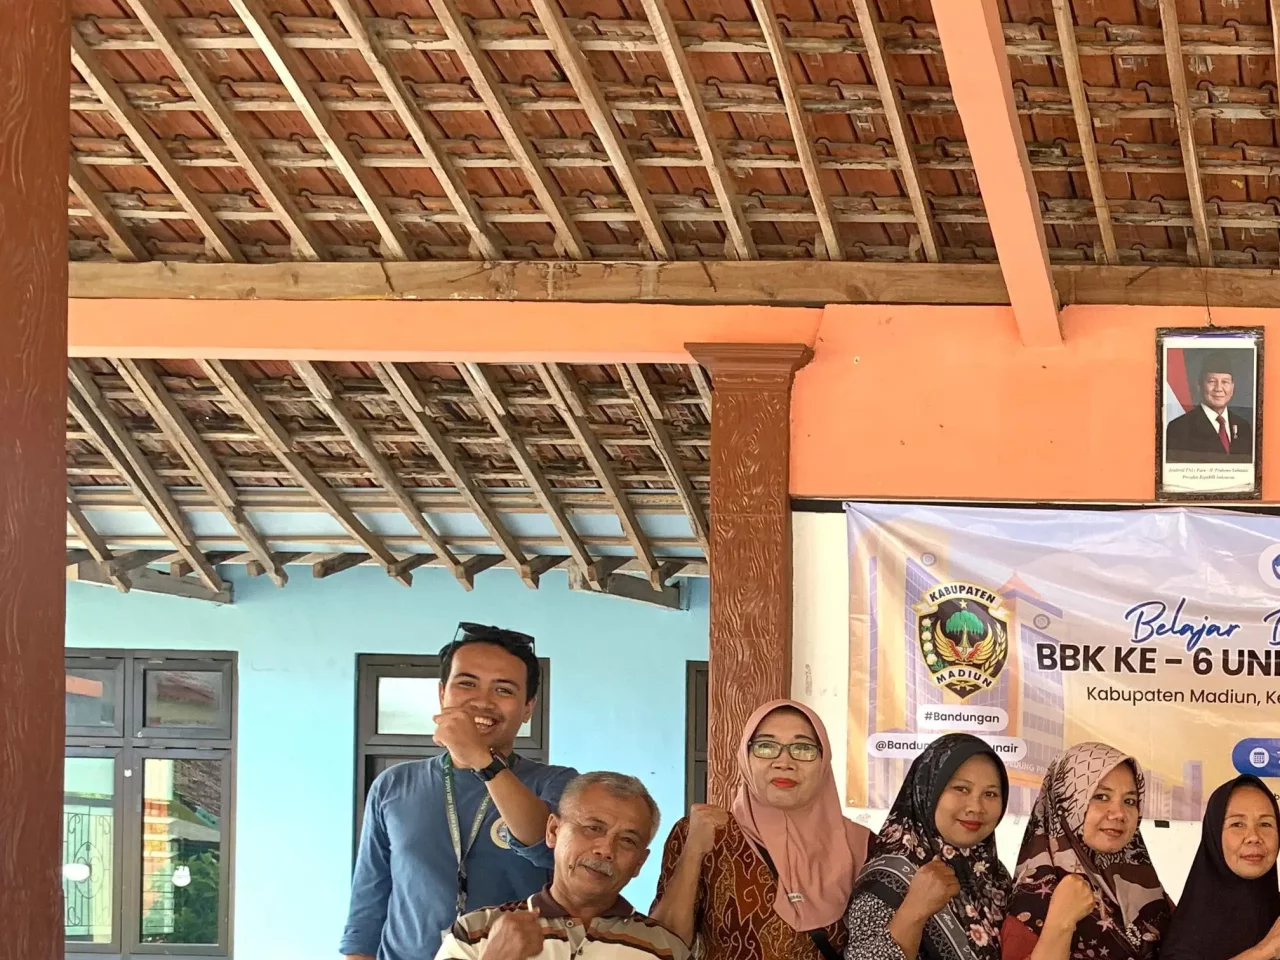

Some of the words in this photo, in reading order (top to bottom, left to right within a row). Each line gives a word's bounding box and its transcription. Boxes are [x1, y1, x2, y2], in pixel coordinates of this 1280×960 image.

[929, 585, 997, 604] KABUPATEN
[1125, 598, 1241, 651] Belajar
[1036, 643, 1107, 672] BBK
[1114, 646, 1157, 673] KE
[1192, 647, 1213, 676] 6
[936, 669, 993, 689] MADIUN
[1087, 686, 1184, 706] Kabupaten
[1190, 688, 1261, 706] Madiun,
[924, 711, 1000, 724] #Bandungan
